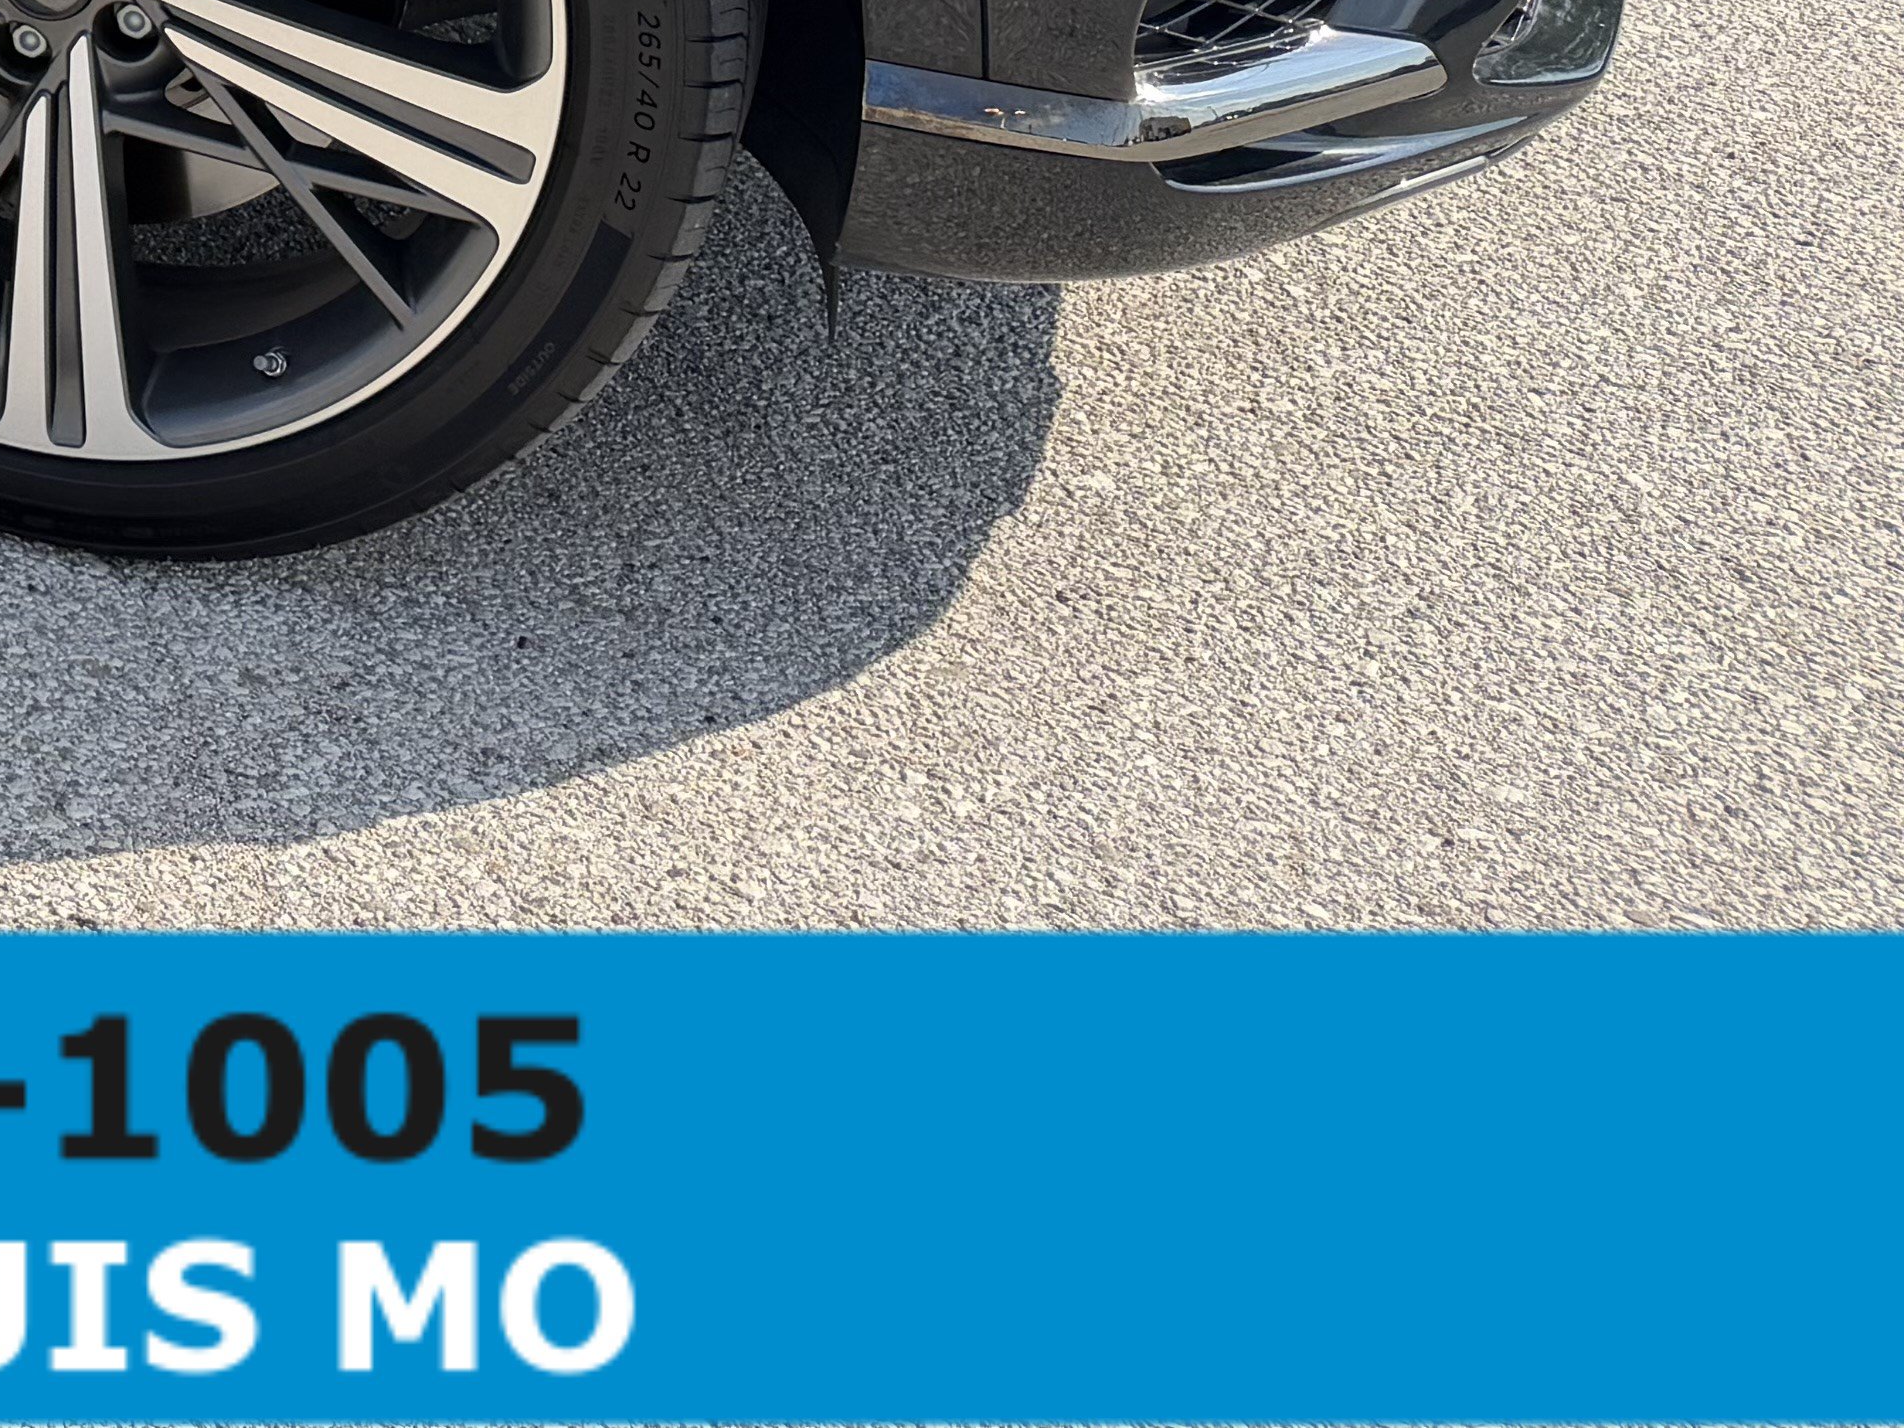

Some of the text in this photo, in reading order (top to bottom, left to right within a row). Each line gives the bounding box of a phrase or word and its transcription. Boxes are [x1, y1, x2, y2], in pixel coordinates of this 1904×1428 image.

[614, 10, 662, 211] 265/40 R 22
[506, 341, 557, 395] OUTSIDE
